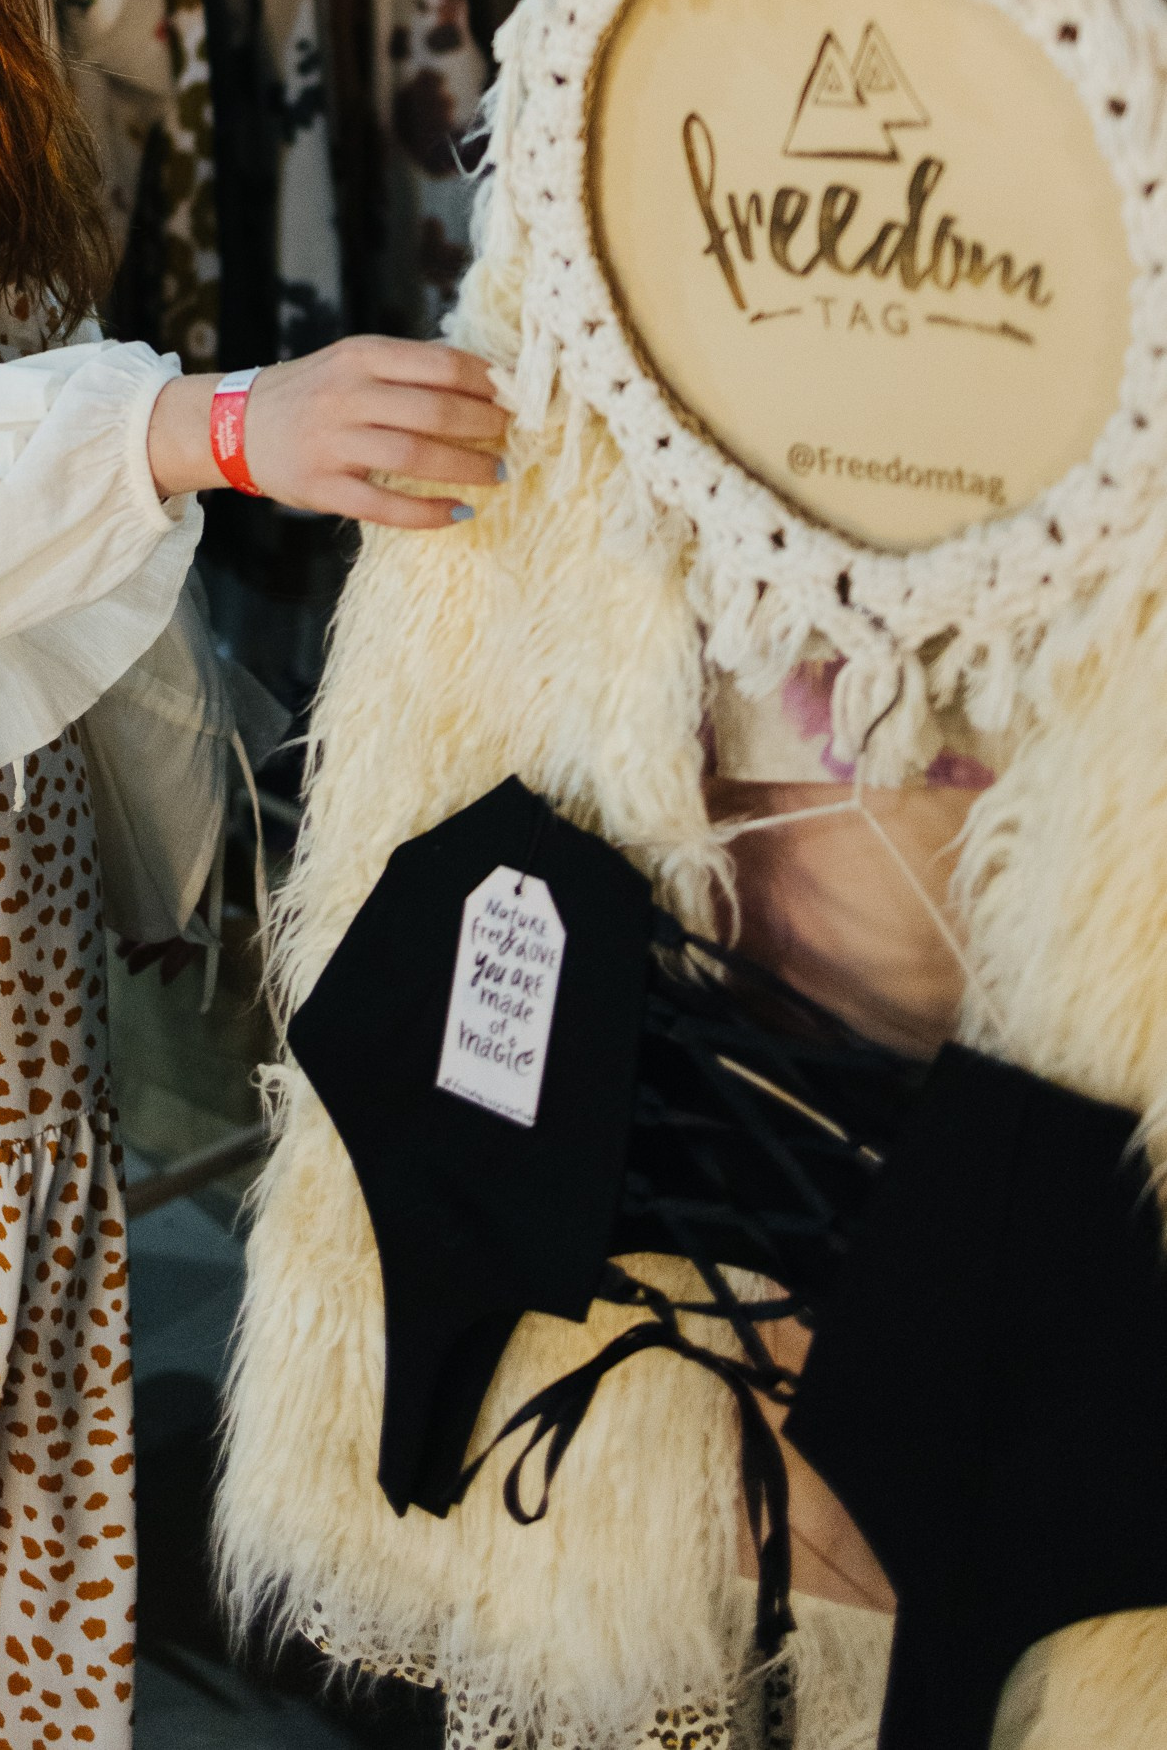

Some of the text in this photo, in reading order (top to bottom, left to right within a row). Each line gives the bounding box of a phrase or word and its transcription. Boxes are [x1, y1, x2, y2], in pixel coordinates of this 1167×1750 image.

[681, 111, 1055, 312] freedom
[812, 295, 912, 337] TAG
[786, 442, 1008, 506] @Freedomtag
[470, 951, 507, 987] you
[479, 987, 534, 1024] made
[489, 1018, 508, 1036] of
